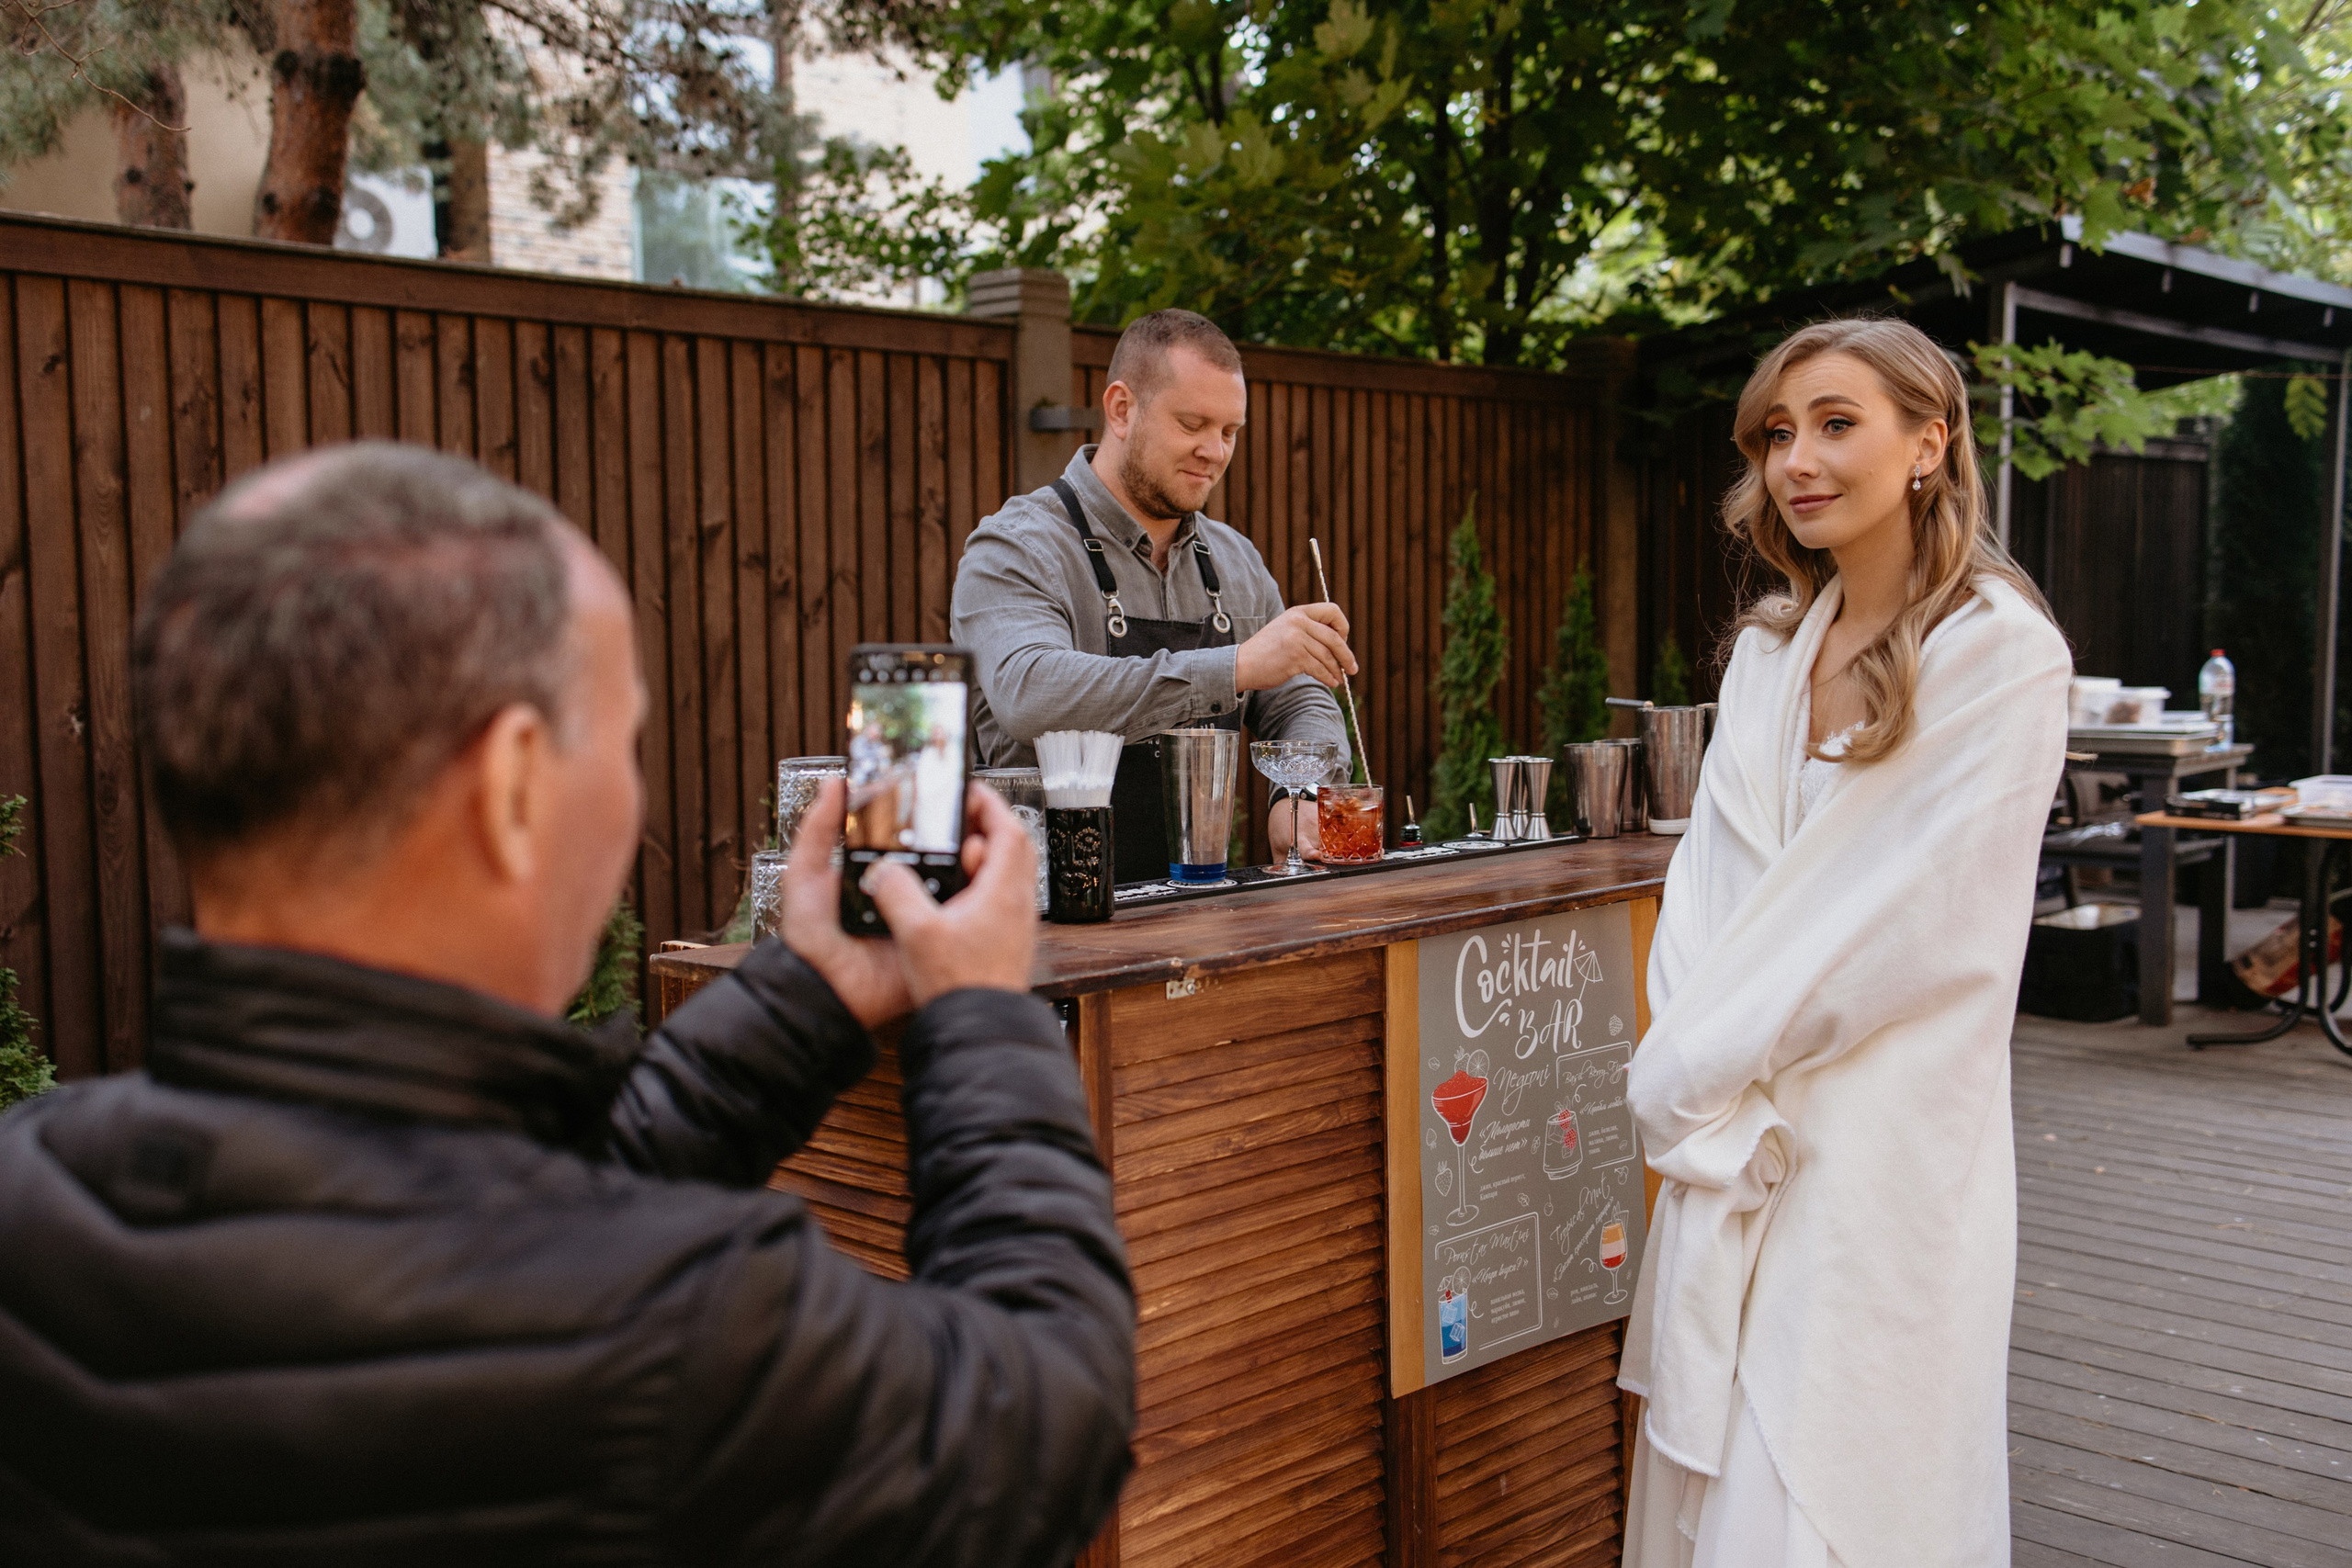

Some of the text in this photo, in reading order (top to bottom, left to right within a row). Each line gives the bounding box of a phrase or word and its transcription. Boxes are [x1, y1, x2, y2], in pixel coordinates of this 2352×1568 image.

[1455, 929, 1577, 1038] Cocktail
[1515, 998, 1583, 1059] BAR
[1493, 1065, 1550, 1115] Negroni
